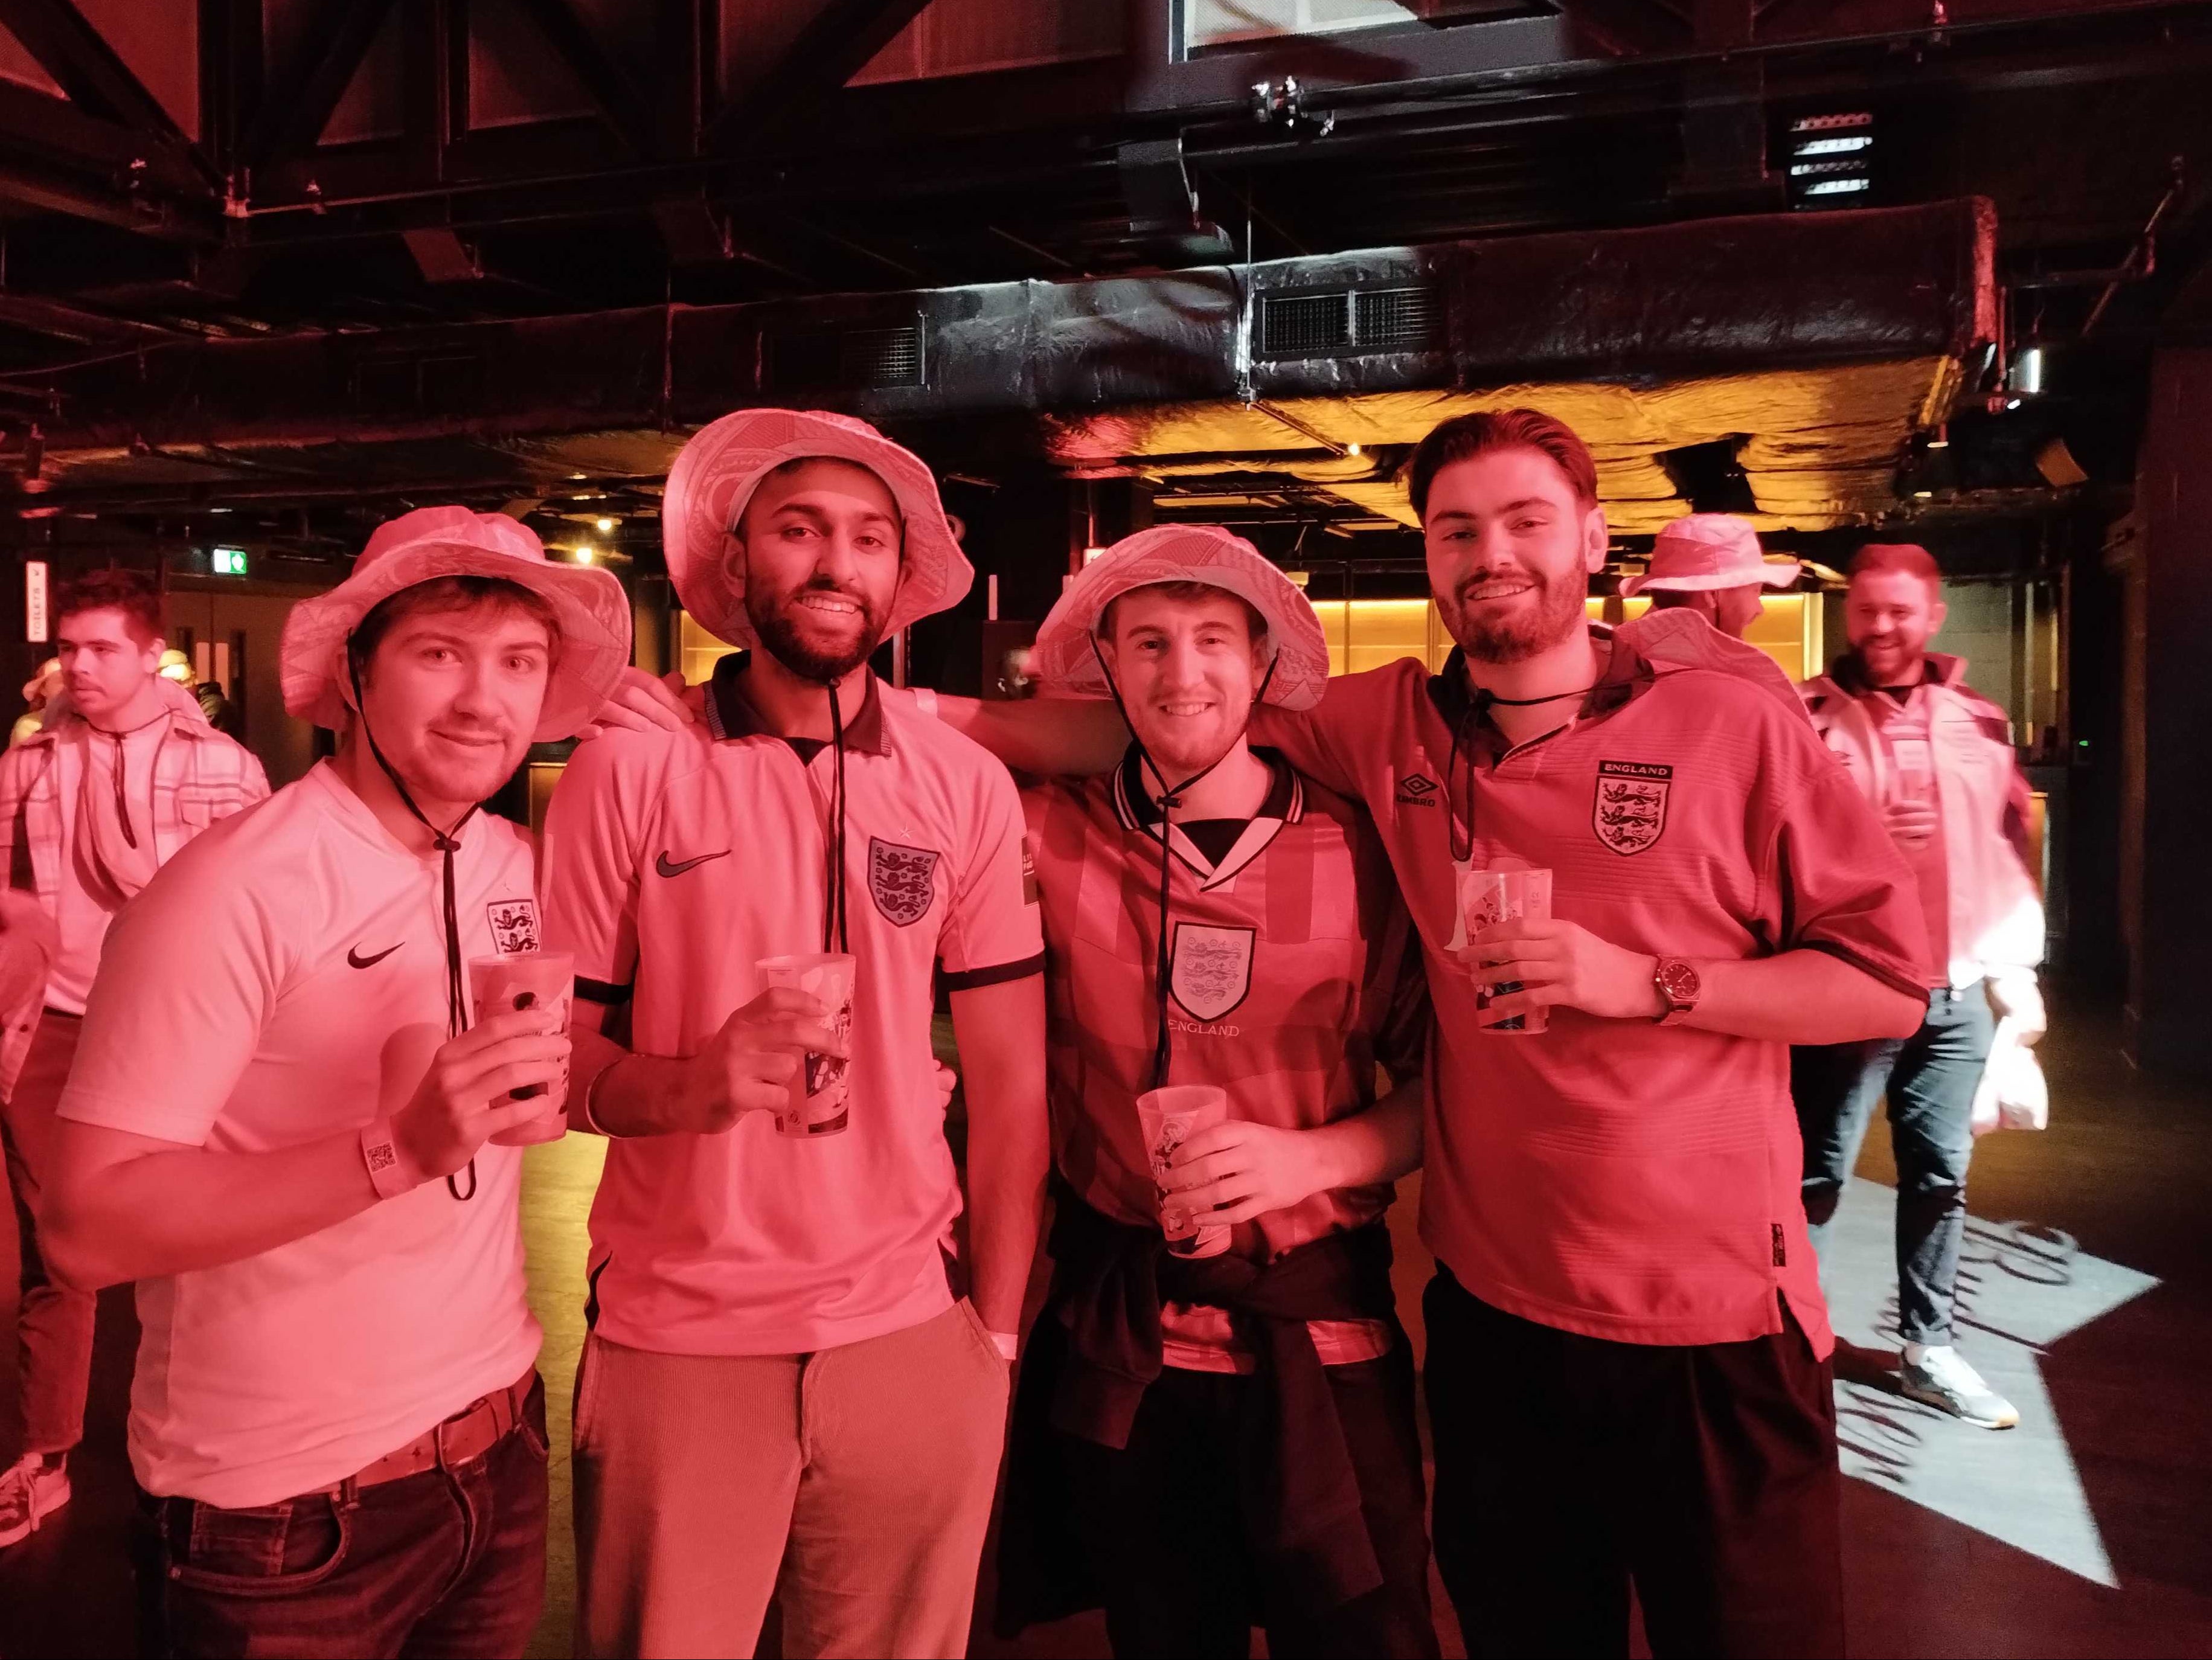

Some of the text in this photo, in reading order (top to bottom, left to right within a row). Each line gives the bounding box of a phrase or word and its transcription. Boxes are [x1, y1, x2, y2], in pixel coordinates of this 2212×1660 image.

[1604, 763, 1668, 775] ENGLAND
[1396, 793, 1435, 807] UMBRO
[1167, 1019, 1240, 1037] ENGLAND
